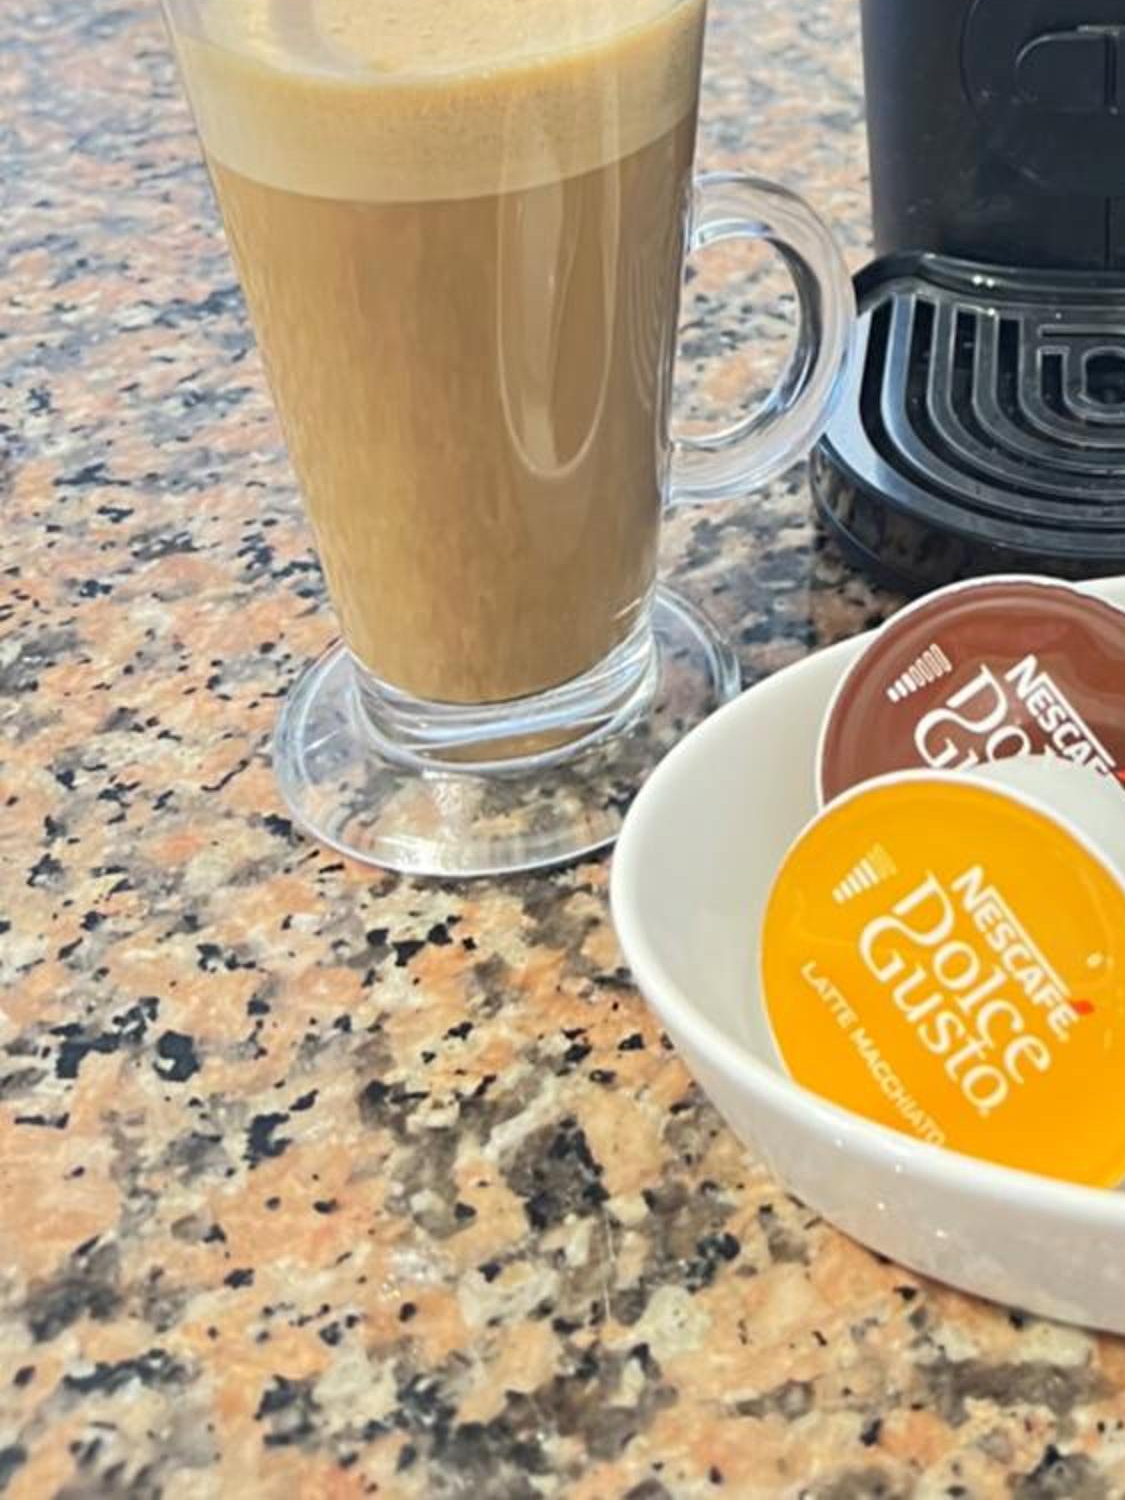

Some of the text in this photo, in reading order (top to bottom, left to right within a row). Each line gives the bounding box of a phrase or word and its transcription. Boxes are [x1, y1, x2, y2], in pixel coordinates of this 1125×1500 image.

[801, 960, 858, 1029] LATTE
[859, 914, 1008, 1116] Gusto
[890, 870, 1051, 1085] Dolce
